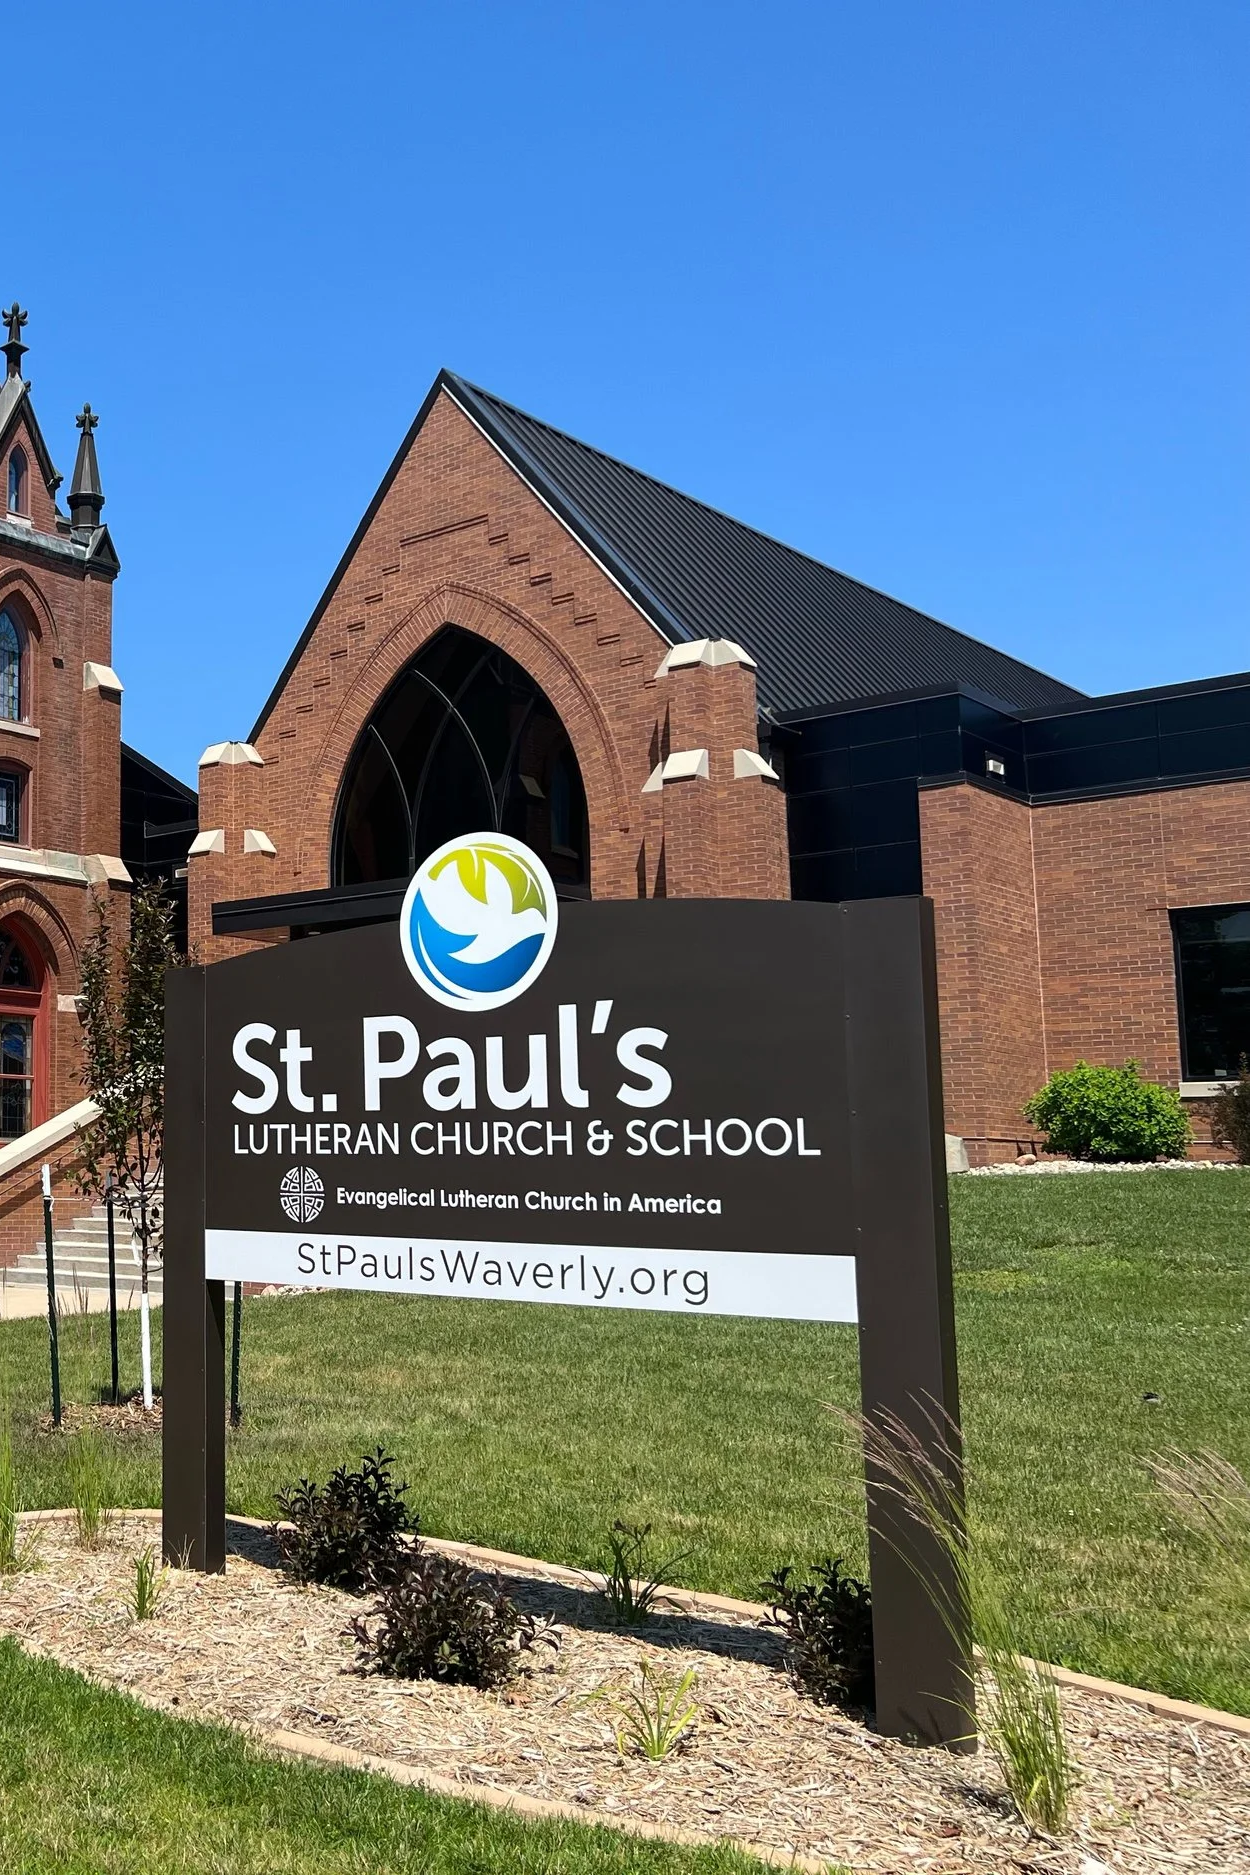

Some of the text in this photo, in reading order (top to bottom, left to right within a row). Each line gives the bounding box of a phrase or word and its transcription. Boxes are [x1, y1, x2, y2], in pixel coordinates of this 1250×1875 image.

[232, 1000, 673, 1114] St. Paul's
[234, 1117, 822, 1157] LUTHERAN CHURCH & SCHOOL
[336, 1187, 722, 1215] Evangelical Lutheran Church in America
[297, 1242, 709, 1306] StPaulsWaverly.org
